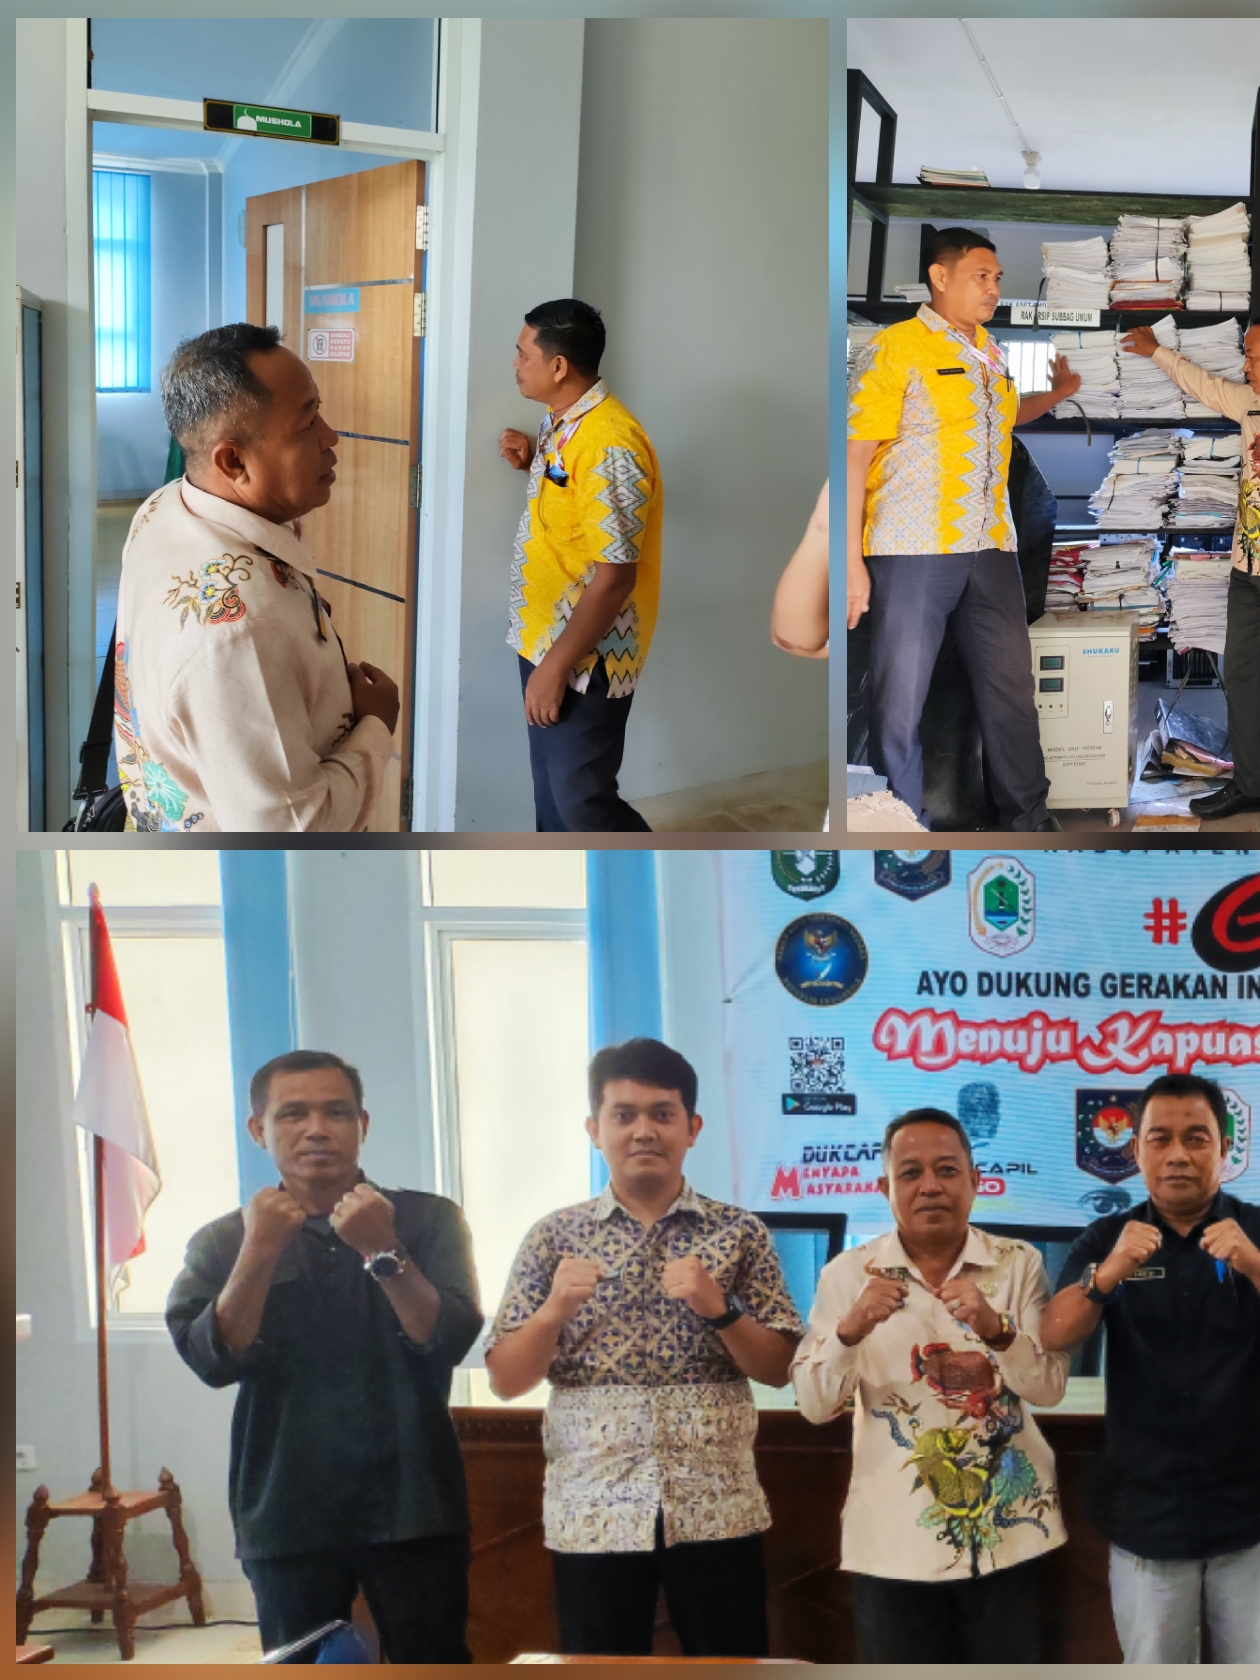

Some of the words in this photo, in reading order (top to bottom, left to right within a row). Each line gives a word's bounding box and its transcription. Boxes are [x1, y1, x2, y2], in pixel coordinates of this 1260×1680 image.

[255, 115, 302, 128] MUSHOLA
[309, 292, 355, 307] MUSHOLA
[1021, 311, 1032, 320] RAK
[1037, 312, 1050, 321] RSIP
[1051, 312, 1074, 321] SUBBAG
[1075, 313, 1093, 322] UMUM
[1082, 647, 1120, 655] SHUKAKU
[916, 970, 968, 996] AYO
[977, 970, 1091, 998] DUKUNG
[1100, 973, 1228, 1000] GERAKAN
[875, 1009, 1075, 1070] Menuju
